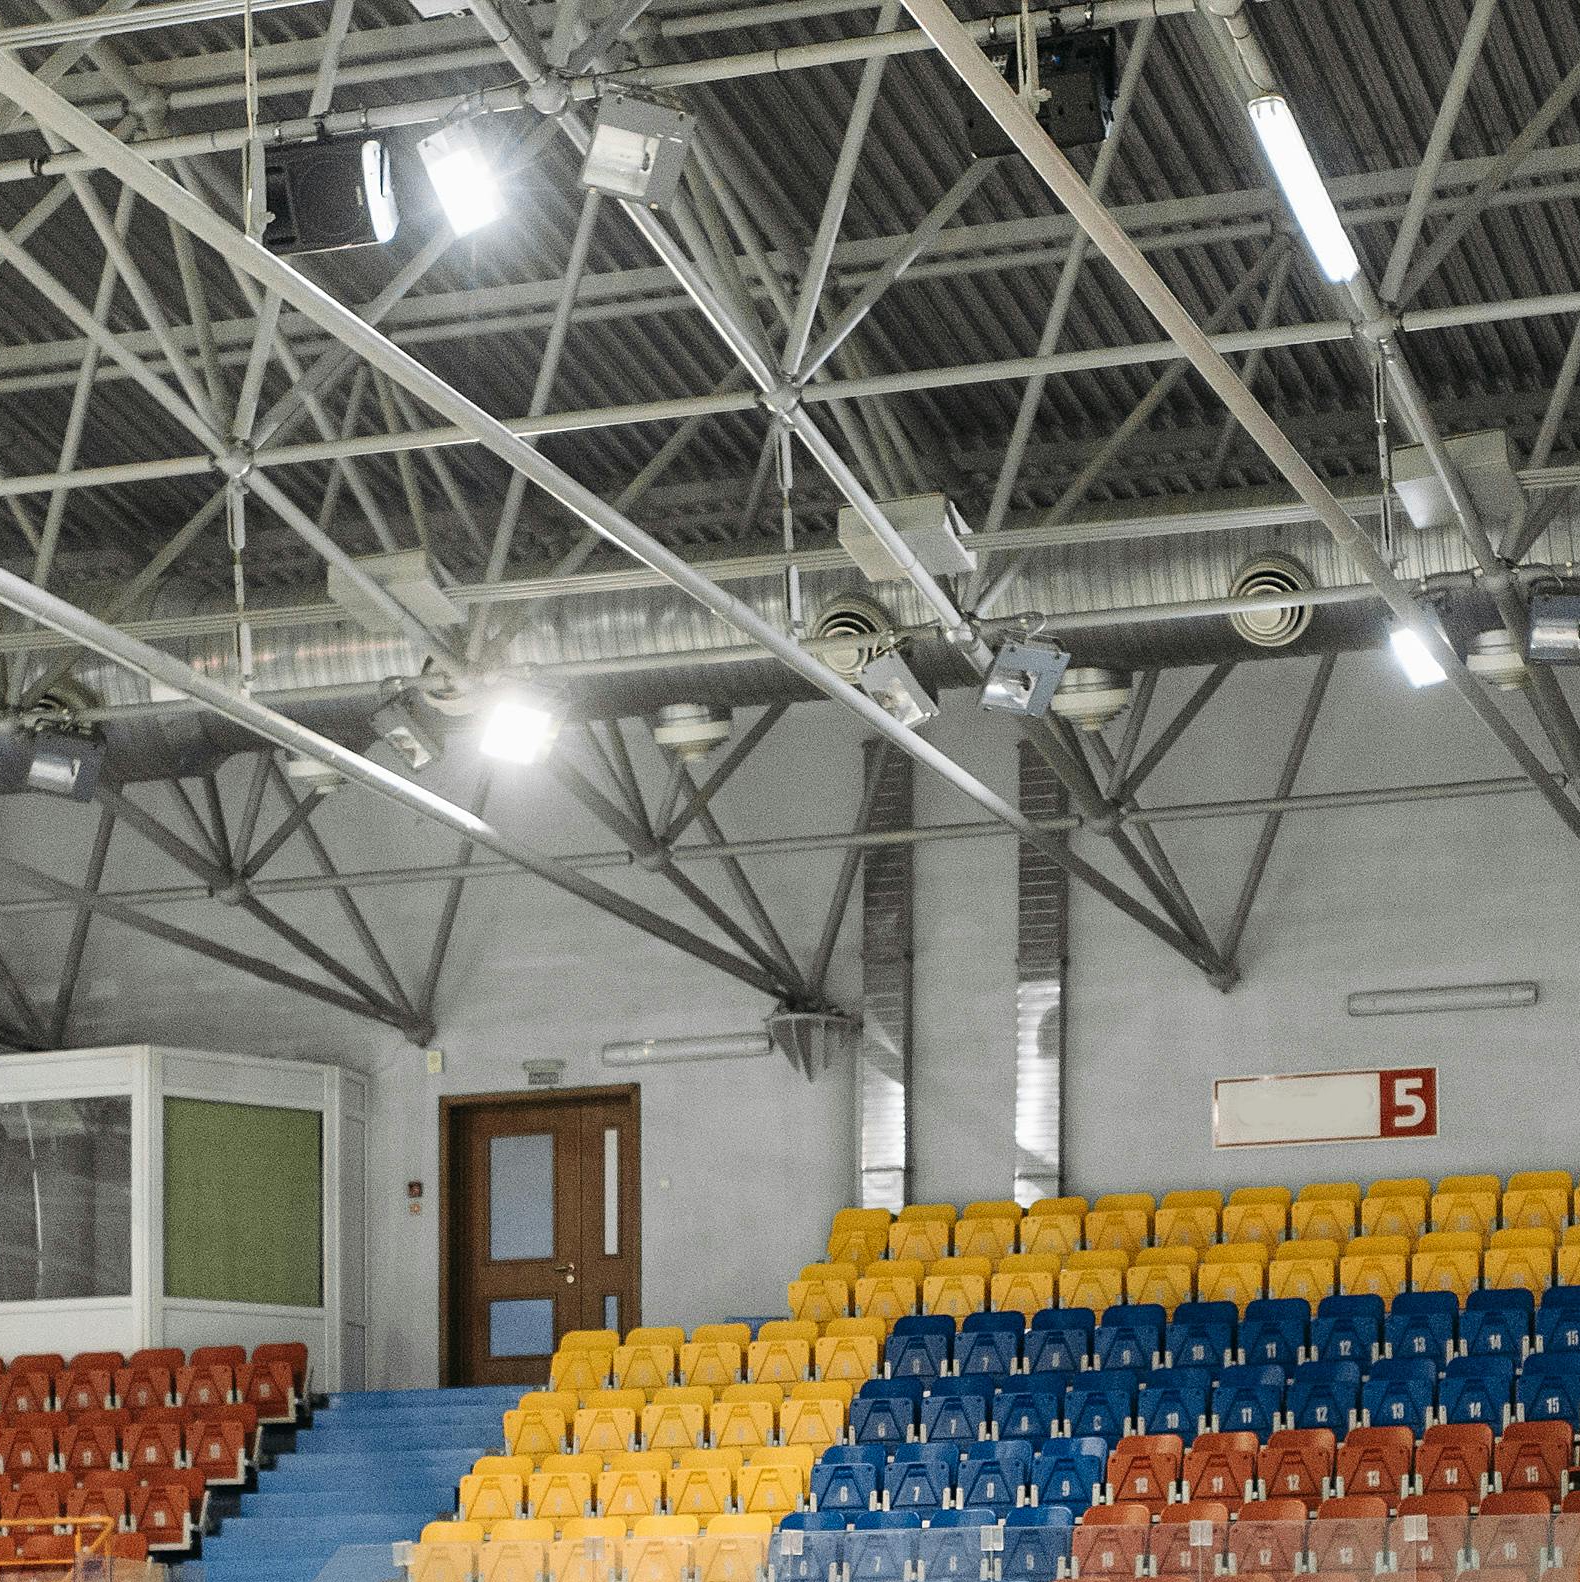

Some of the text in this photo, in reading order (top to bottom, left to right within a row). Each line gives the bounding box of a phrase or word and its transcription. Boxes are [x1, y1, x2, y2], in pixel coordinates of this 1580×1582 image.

[1393, 1077, 1427, 1128] 5
[1413, 1337, 1426, 1352] 13
[1489, 1334, 1501, 1349] 14
[1566, 1330, 1579, 1345] 15
[1192, 1345, 1204, 1360] 10
[1266, 1343, 1276, 1357] 11
[1339, 1340, 1351, 1355] 12
[1391, 1403, 1404, 1419] 13
[1469, 1402, 1481, 1417] 14
[1546, 1397, 1559, 1413] 15
[1166, 1413, 1179, 1428] 10
[1241, 1408, 1252, 1423] 11
[1316, 1406, 1327, 1422] 12
[1367, 1471, 1379, 1486] 13
[1445, 1469, 1457, 1484] 14
[1525, 1466, 1538, 1482] 15
[986, 1482, 994, 1498] 8
[1062, 1480, 1070, 1496] 9
[1135, 1477, 1148, 1493] 10
[1212, 1477, 1223, 1492] 11
[1287, 1475, 1299, 1490] 12
[838, 1486, 849, 1503] 6
[913, 1486, 920, 1502] 7
